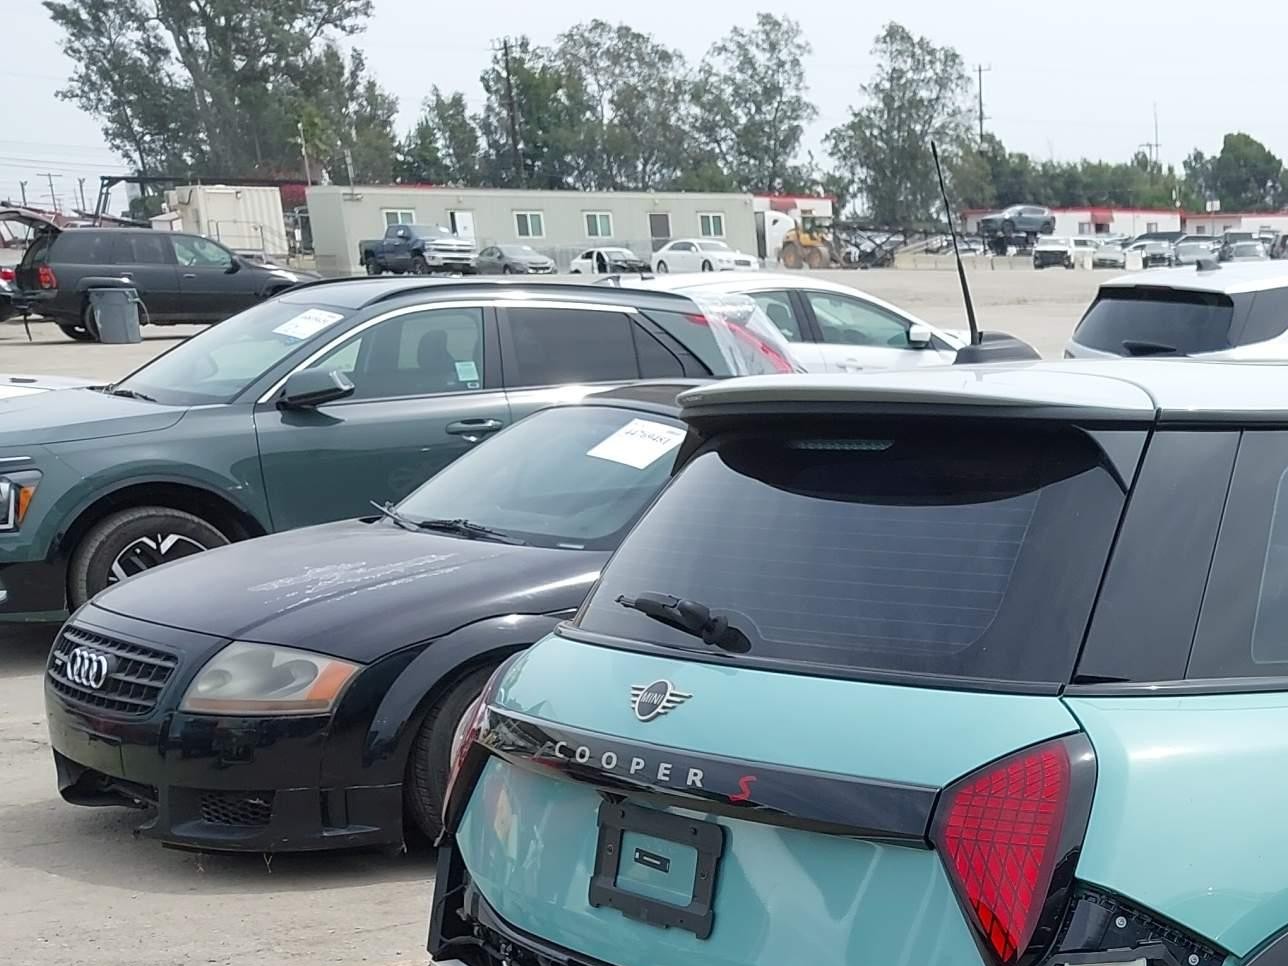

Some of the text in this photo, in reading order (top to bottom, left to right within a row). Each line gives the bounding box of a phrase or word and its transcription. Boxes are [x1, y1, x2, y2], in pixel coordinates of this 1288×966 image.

[640, 691, 665, 705] MINI
[554, 740, 758, 802] COOPER S
